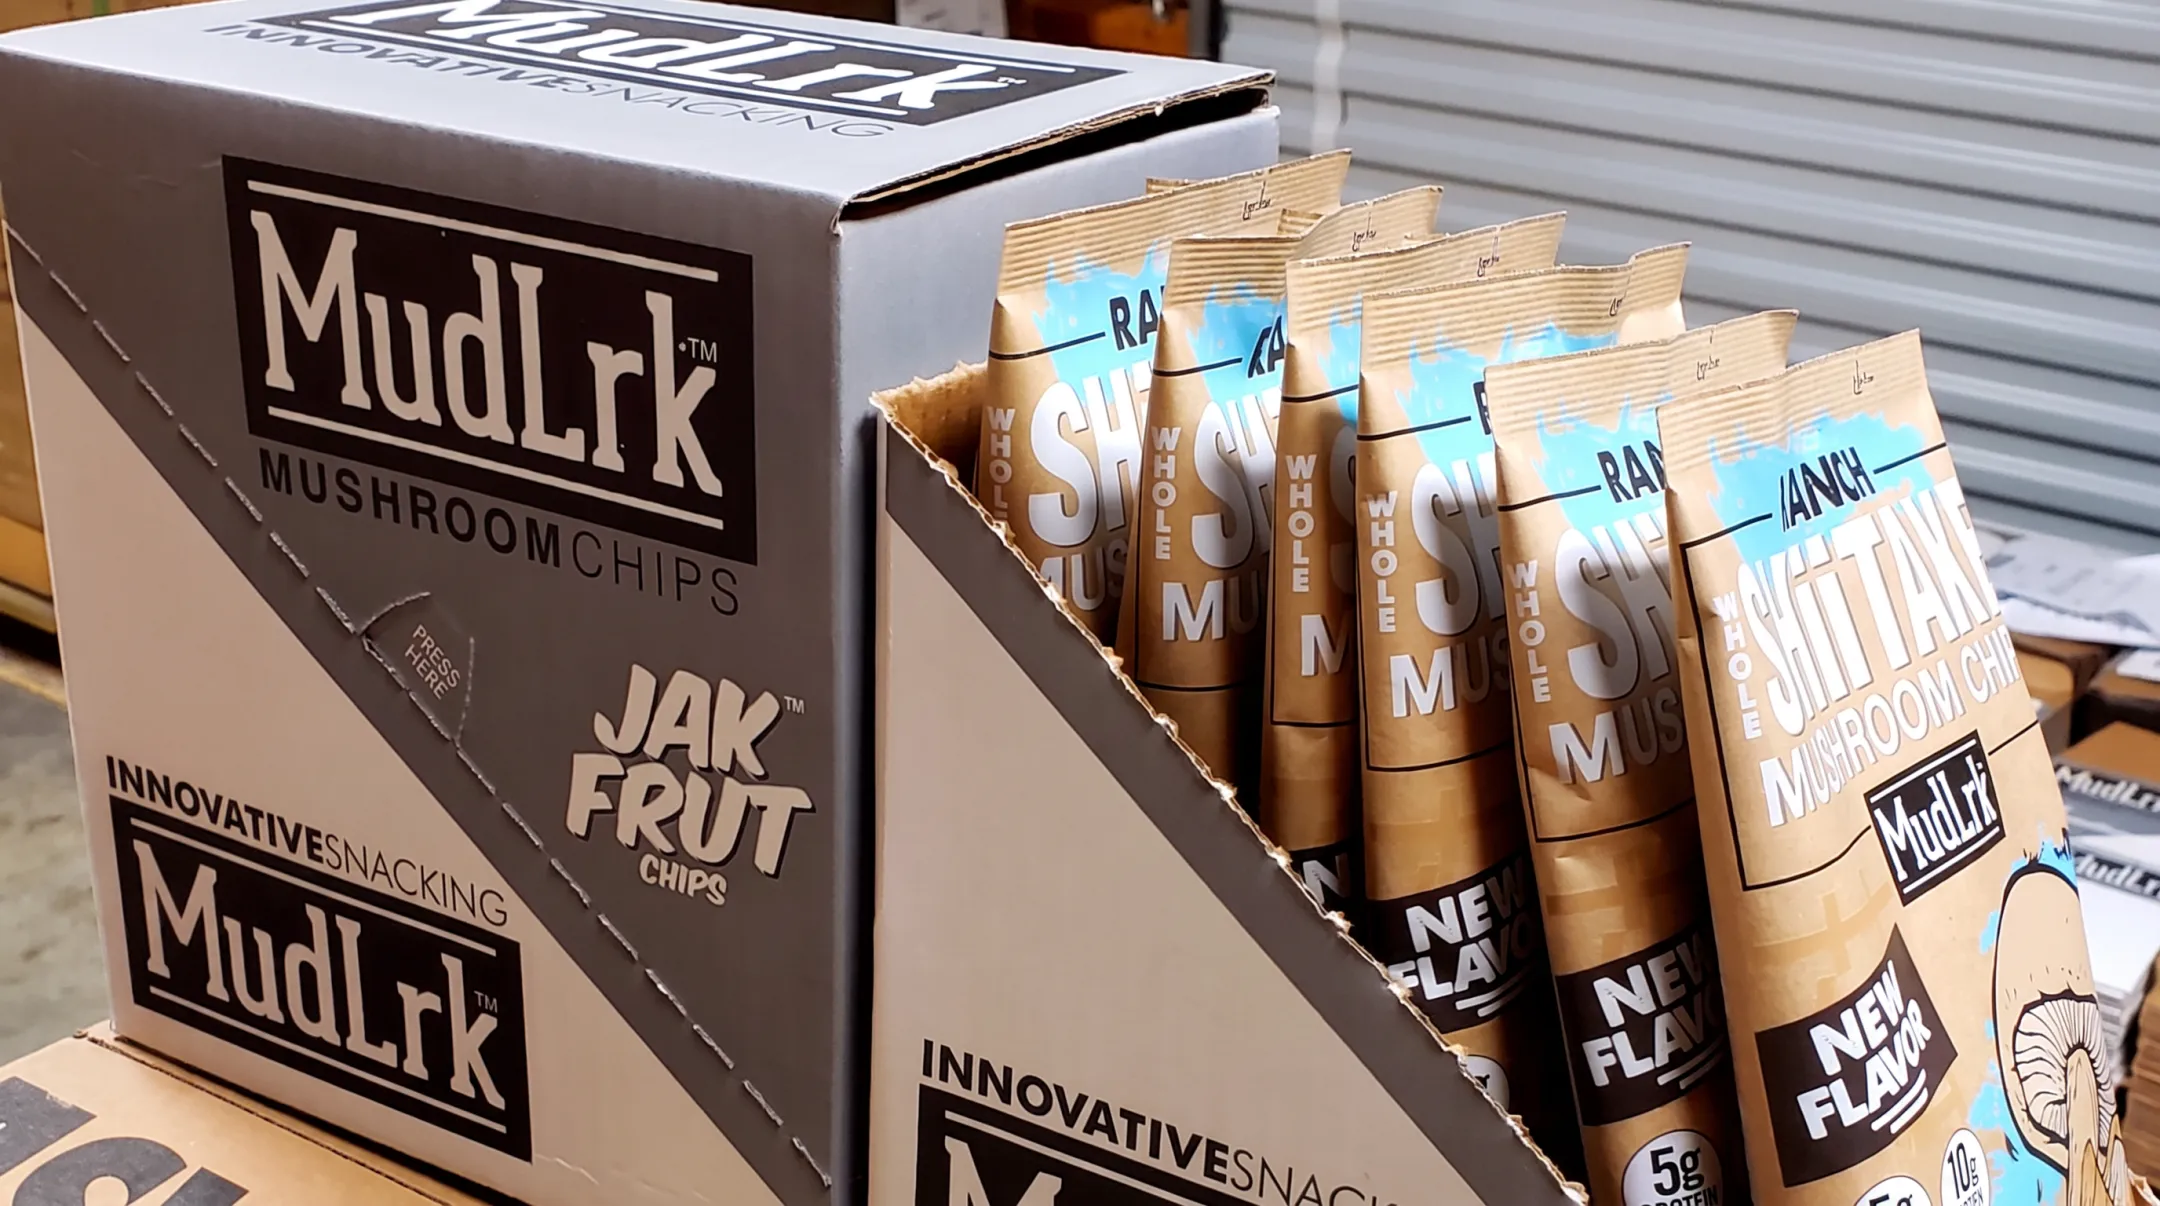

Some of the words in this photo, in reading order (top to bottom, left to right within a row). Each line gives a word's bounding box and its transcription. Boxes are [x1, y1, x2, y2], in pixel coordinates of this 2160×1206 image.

[250, 209, 724, 498] MudLrk
[1109, 284, 1164, 351] RA
[1152, 426, 1182, 560] WHOLE
[1285, 453, 1318, 593] WHOLE
[1366, 490, 1399, 633] WHOLE
[404, 643, 448, 700] HERE
[411, 623, 462, 690] PRESS
[1507, 559, 1552, 703] WHOLE
[1713, 591, 1763, 740] WHOLE
[594, 663, 781, 781] JAK
[1759, 658, 1968, 827] MUSHROOM
[566, 751, 816, 880] FRUT
[639, 853, 728, 906] CHIPS
[1873, 752, 2000, 883] MudLrk
[1404, 855, 1527, 955] NEW
[133, 838, 506, 1111] MudLrk
[1809, 958, 1905, 1077] NEW
[1796, 998, 1932, 1141] FLAVOR
[1650, 1147, 1705, 1197] 5g
[1947, 1142, 1980, 1200] 10g
